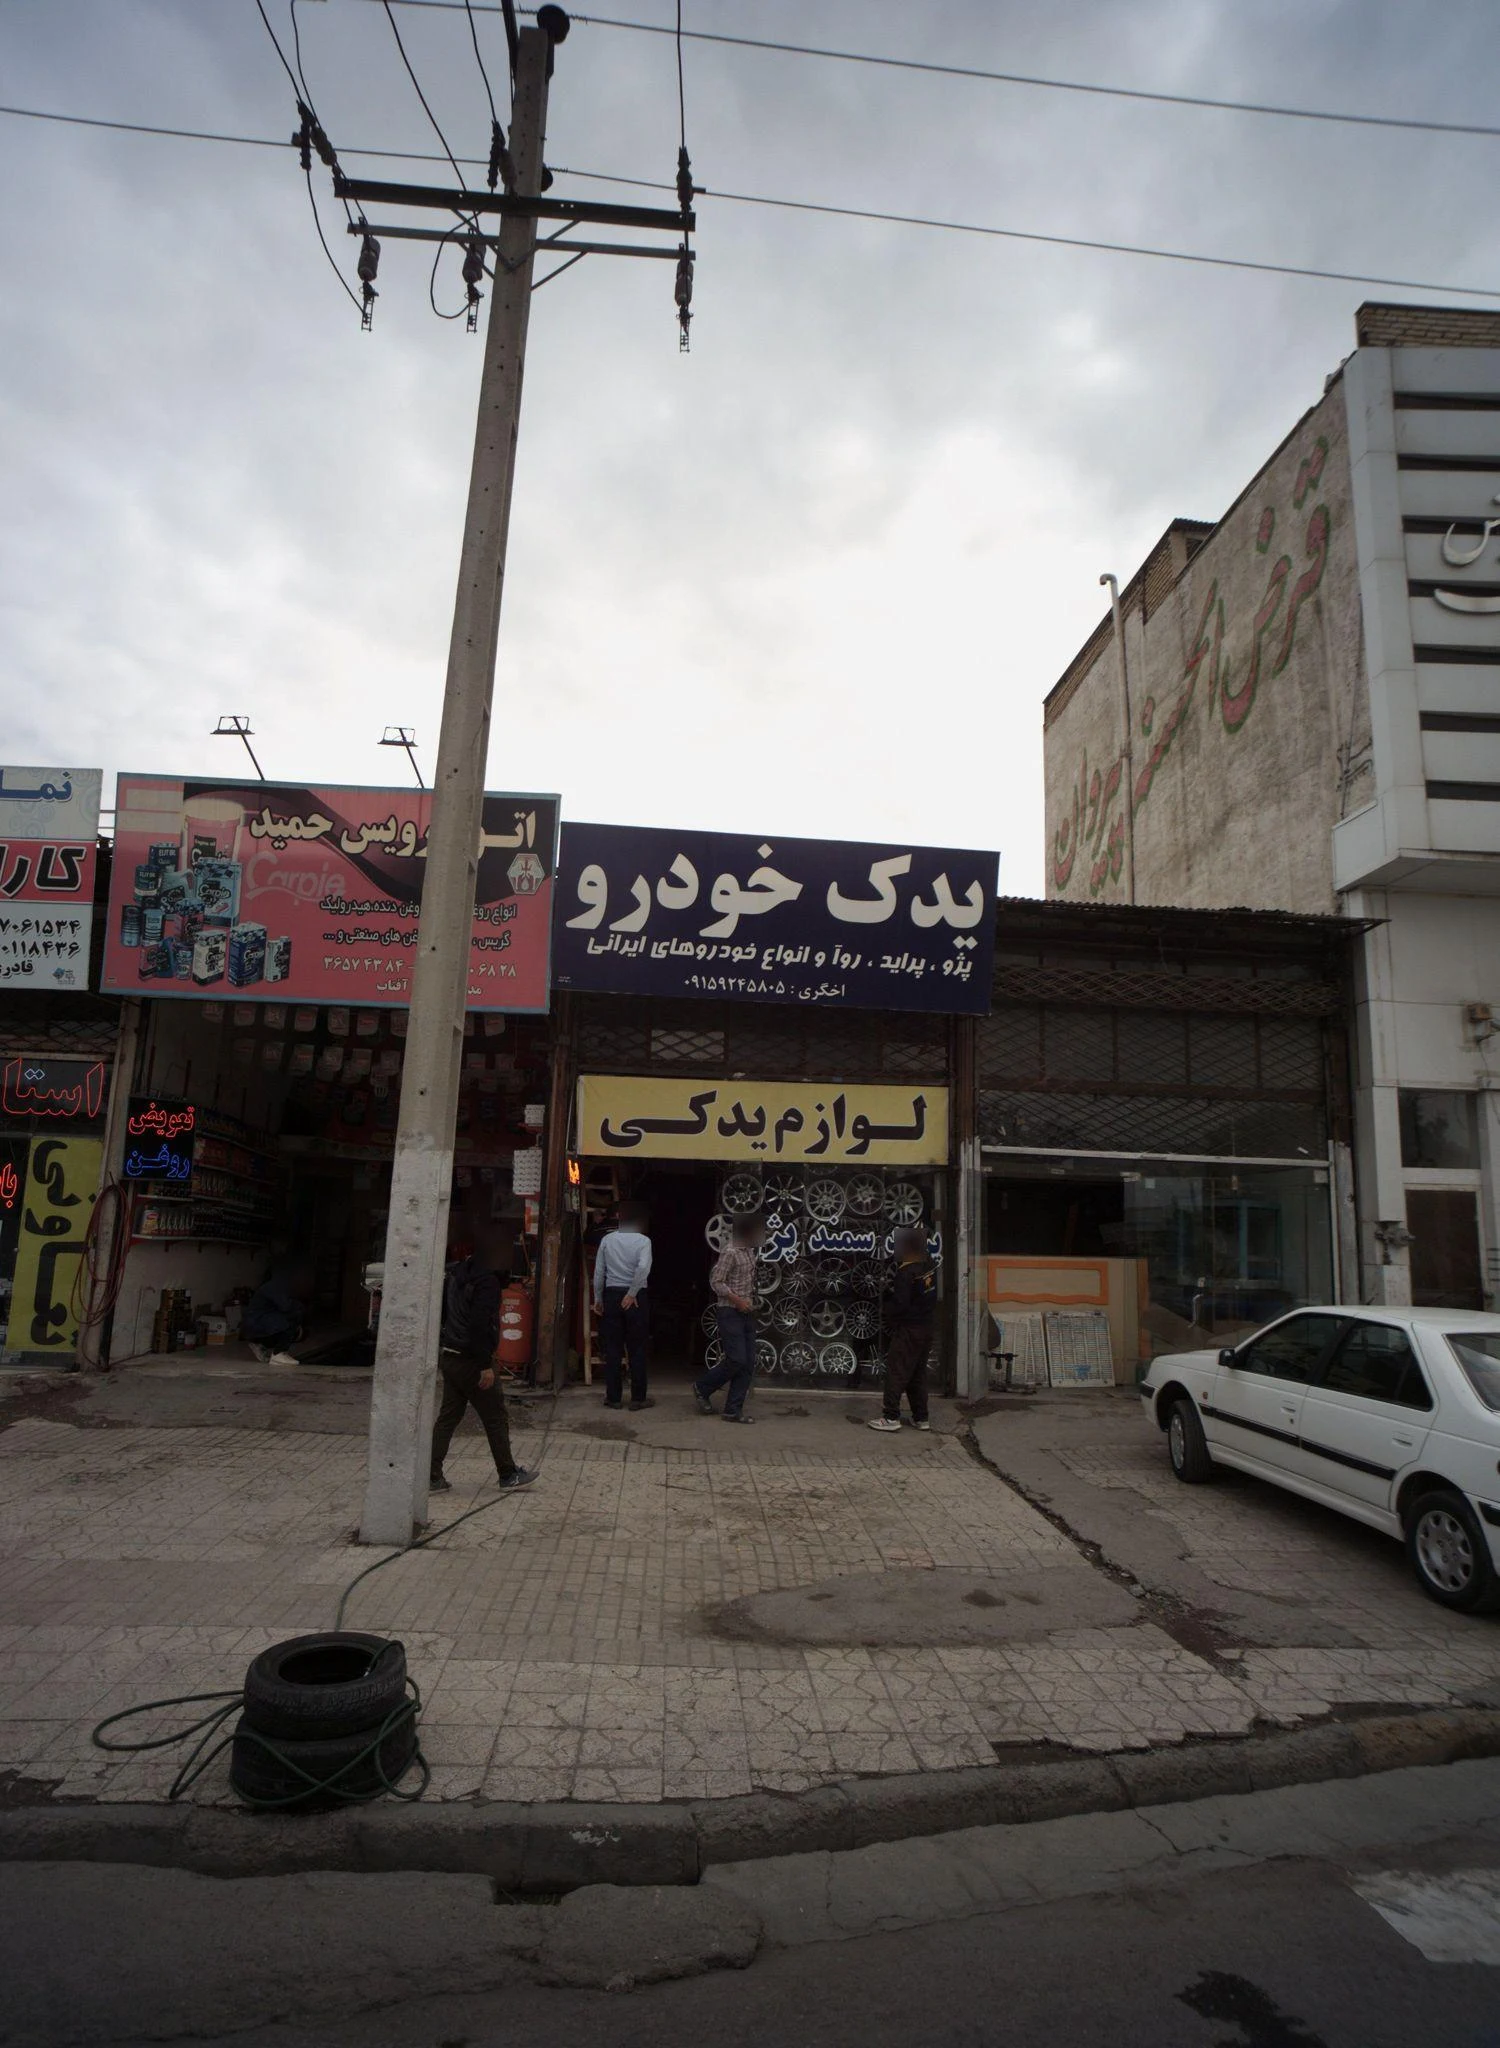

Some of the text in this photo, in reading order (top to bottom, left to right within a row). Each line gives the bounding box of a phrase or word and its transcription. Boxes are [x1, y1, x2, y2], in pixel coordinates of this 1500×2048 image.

[250, 807, 334, 850] حمید
[565, 843, 984, 950] یدک خودرو
[491, 903, 518, 926] انواع
[345, 927, 379, 944] صنعتی
[586, 934, 647, 958] ایرانی
[651, 937, 756, 963] خودروهای
[761, 945, 811, 970] انواع
[814, 950, 826, 967] و
[880, 952, 926, 979] پراید
[942, 952, 973, 981] پژو
[684, 974, 845, 1001] اخگری ۰۹۱۵۹۲۴۵۸۰۵
[128, 1102, 196, 1138] تعویض
[600, 1089, 928, 1156] لوازم یدکی
[125, 1143, 191, 1179] روغن
[758, 1213, 800, 1264] پژ
[809, 1215, 876, 1252] سمند
